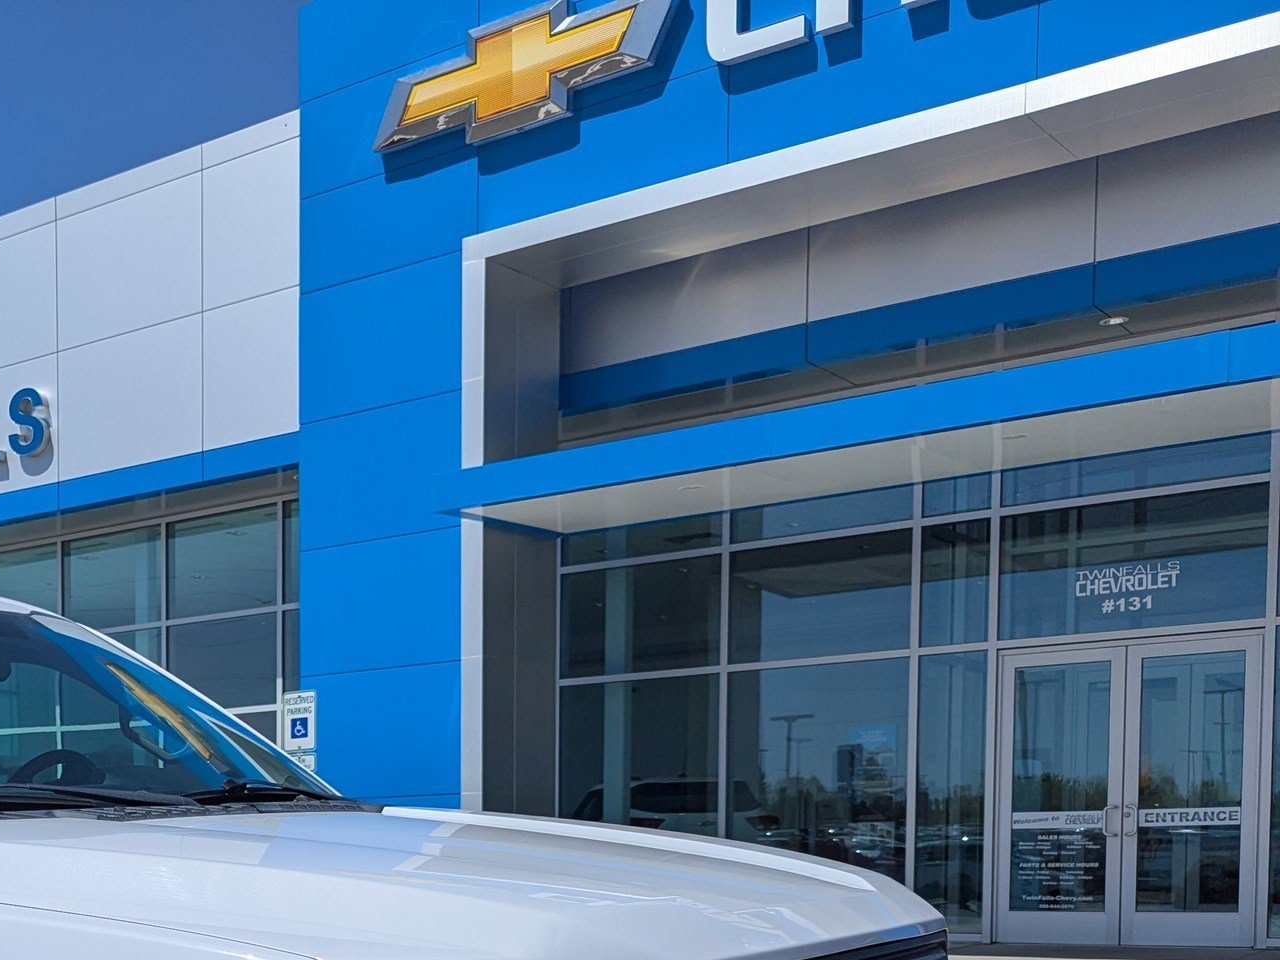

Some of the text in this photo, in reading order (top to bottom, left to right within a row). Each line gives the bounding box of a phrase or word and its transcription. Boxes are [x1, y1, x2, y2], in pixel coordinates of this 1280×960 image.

[1076, 560, 1180, 580] TWINFALLS
[1075, 571, 1181, 597] CHEVROLET
[1101, 595, 1152, 614] #131
[284, 695, 314, 706] RESERVED
[286, 706, 312, 716] PARKING
[1013, 816, 1049, 825] Welcome
[1144, 810, 1239, 824] ENTRANCE
